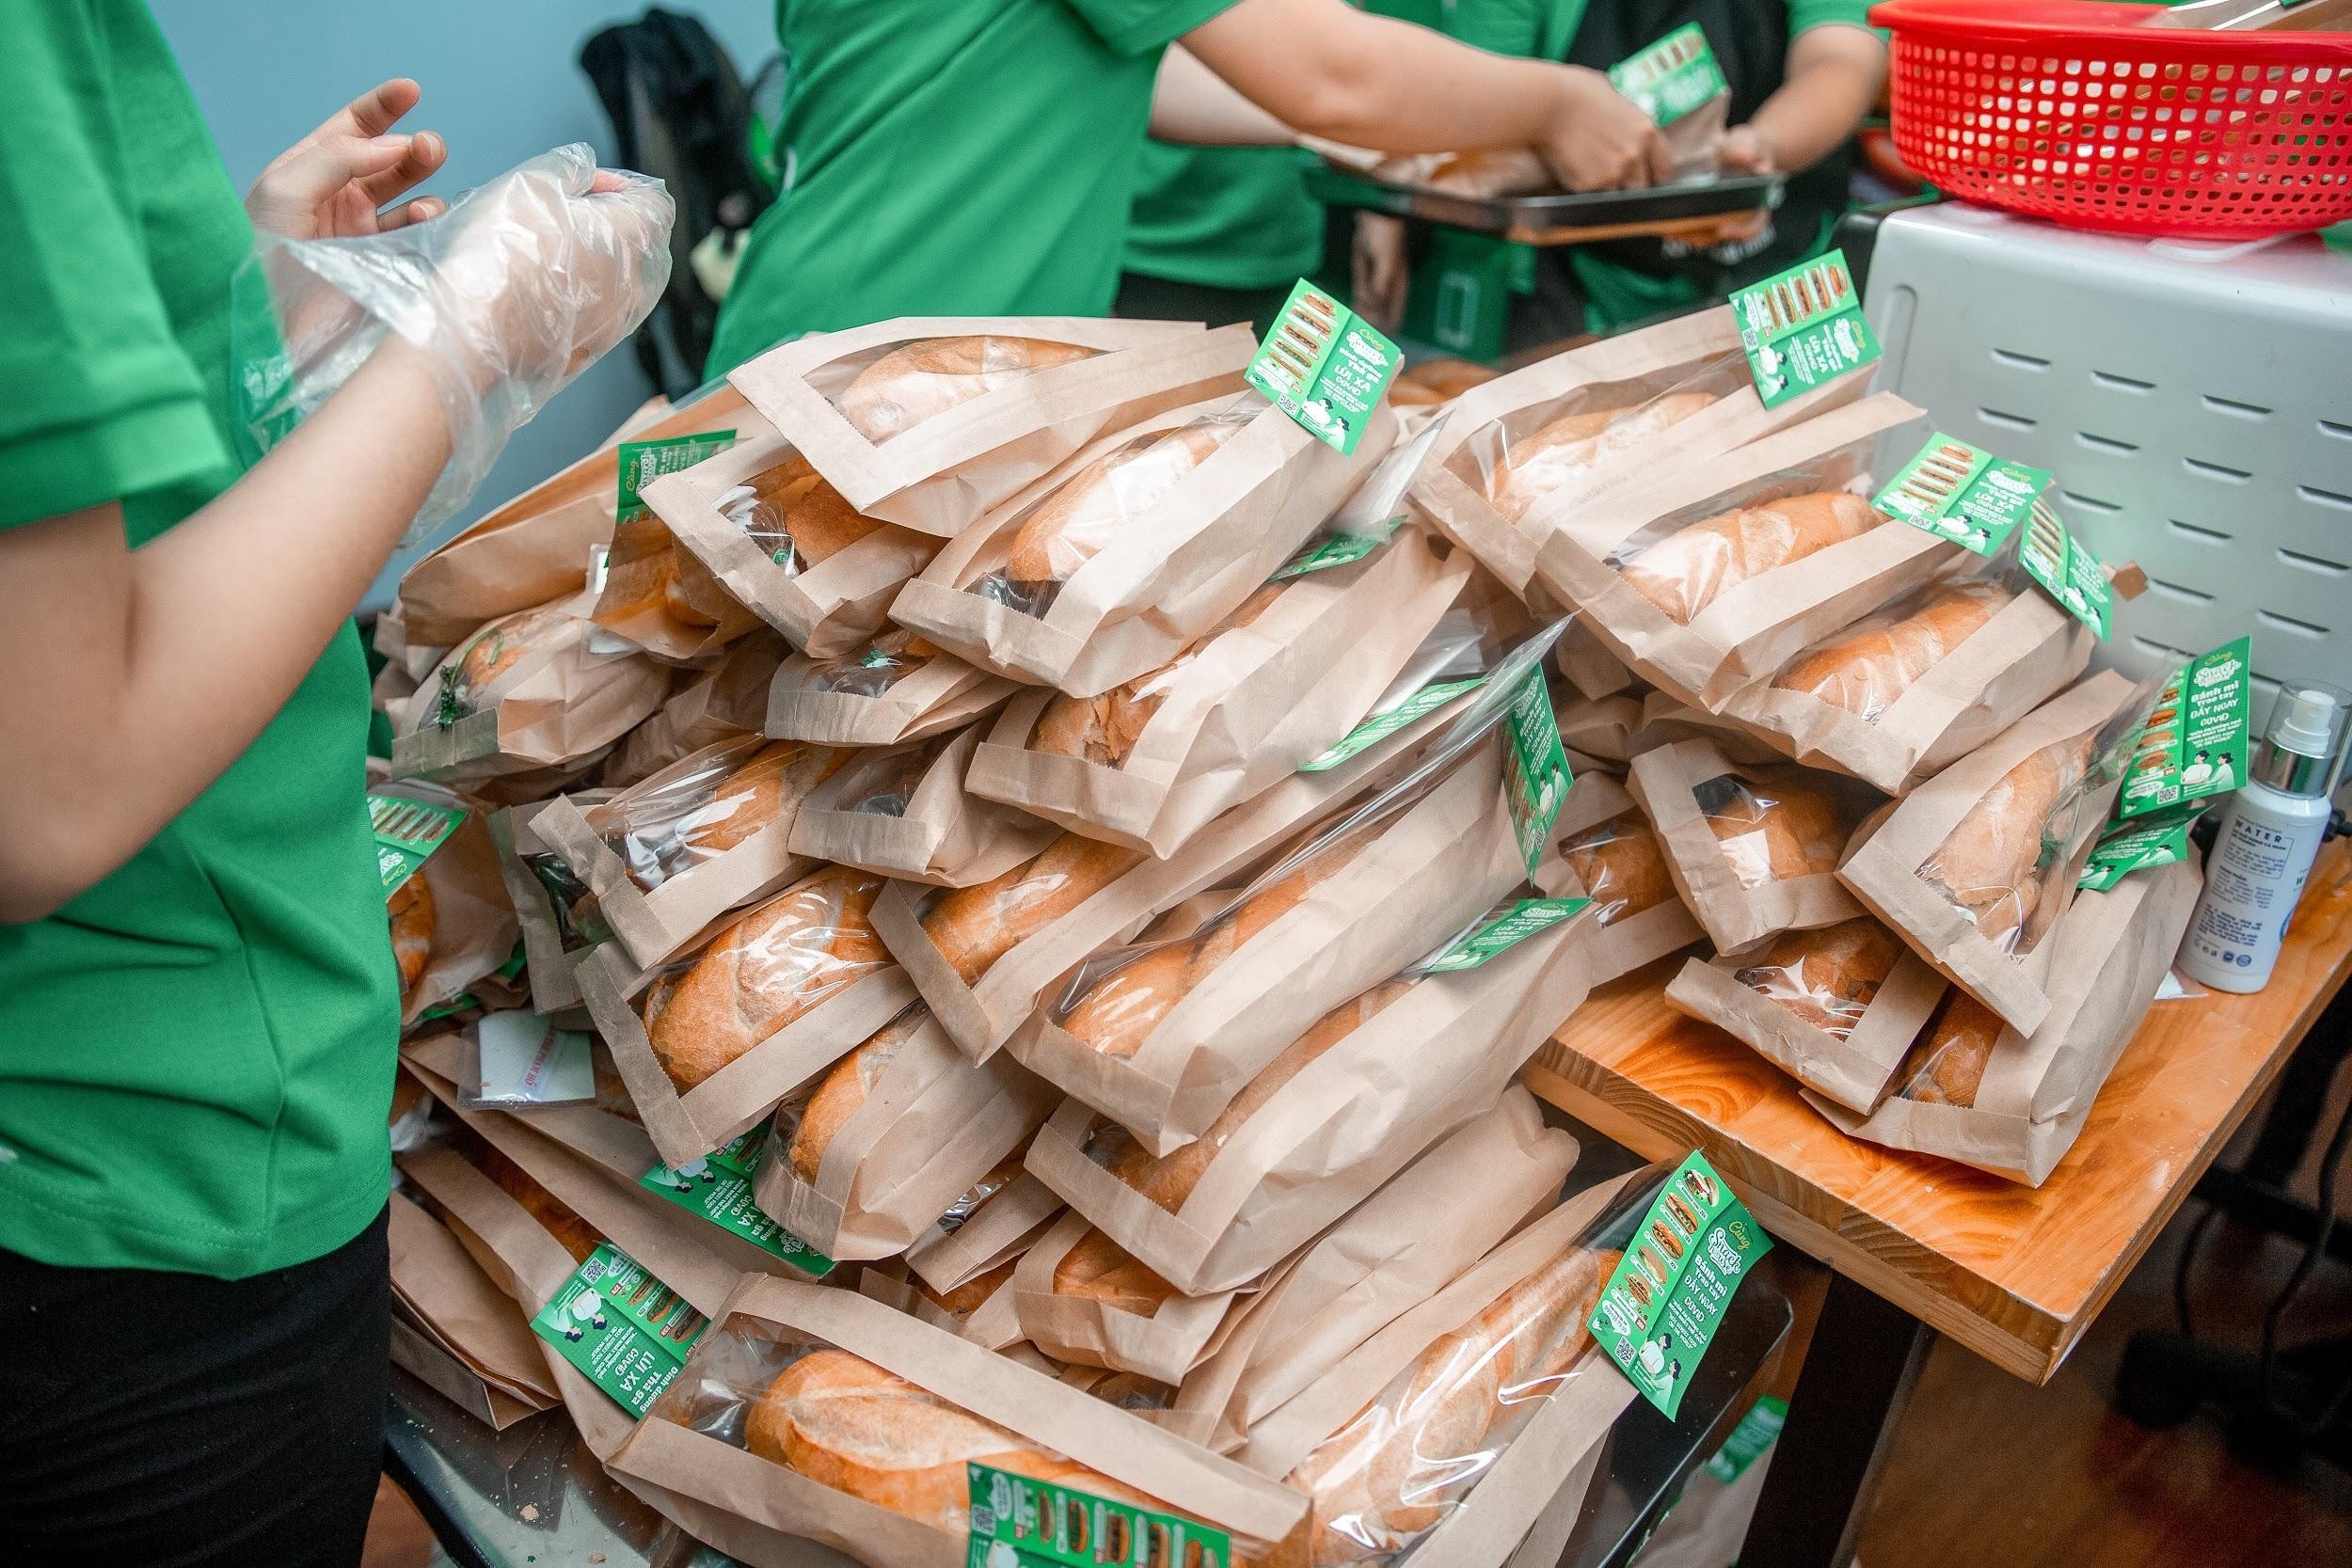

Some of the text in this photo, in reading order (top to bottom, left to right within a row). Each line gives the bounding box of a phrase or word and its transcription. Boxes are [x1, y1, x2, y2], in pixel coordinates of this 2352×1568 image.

[1354, 377, 1370, 392] XA
[627, 459, 639, 491] Cùng
[2224, 680, 2238, 692] mì
[2214, 699, 2238, 712] NGAY
[2201, 713, 2229, 726] COVID
[2234, 818, 2281, 843] WATER
[731, 1196, 753, 1215] COVID
[738, 1212, 756, 1226] XA
[751, 1225, 763, 1235] ga
[760, 1223, 780, 1241] ưỡng
[1729, 1221, 1750, 1250] Cùng
[1707, 1242, 1732, 1274] house
[1708, 1225, 1741, 1274] Snack
[1695, 1255, 1727, 1296] Bánh mì
[1695, 1268, 1720, 1300] Trao tay
[610, 1283, 621, 1295] 27K
[1685, 1296, 1705, 1322] COVID
[1699, 1293, 1718, 1315] NGAY
[603, 1334, 612, 1342] THE
[660, 1324, 670, 1336] 25K
[601, 1337, 615, 1354] STREET
[592, 1353, 602, 1365] FOOD
[615, 1349, 639, 1375] COVID
[597, 1368, 607, 1380] PHỐ
[619, 1351, 655, 1391] LÙI XA
[631, 1371, 661, 1405] Thả ga
[640, 1367, 678, 1413] Dinh dưỡng
